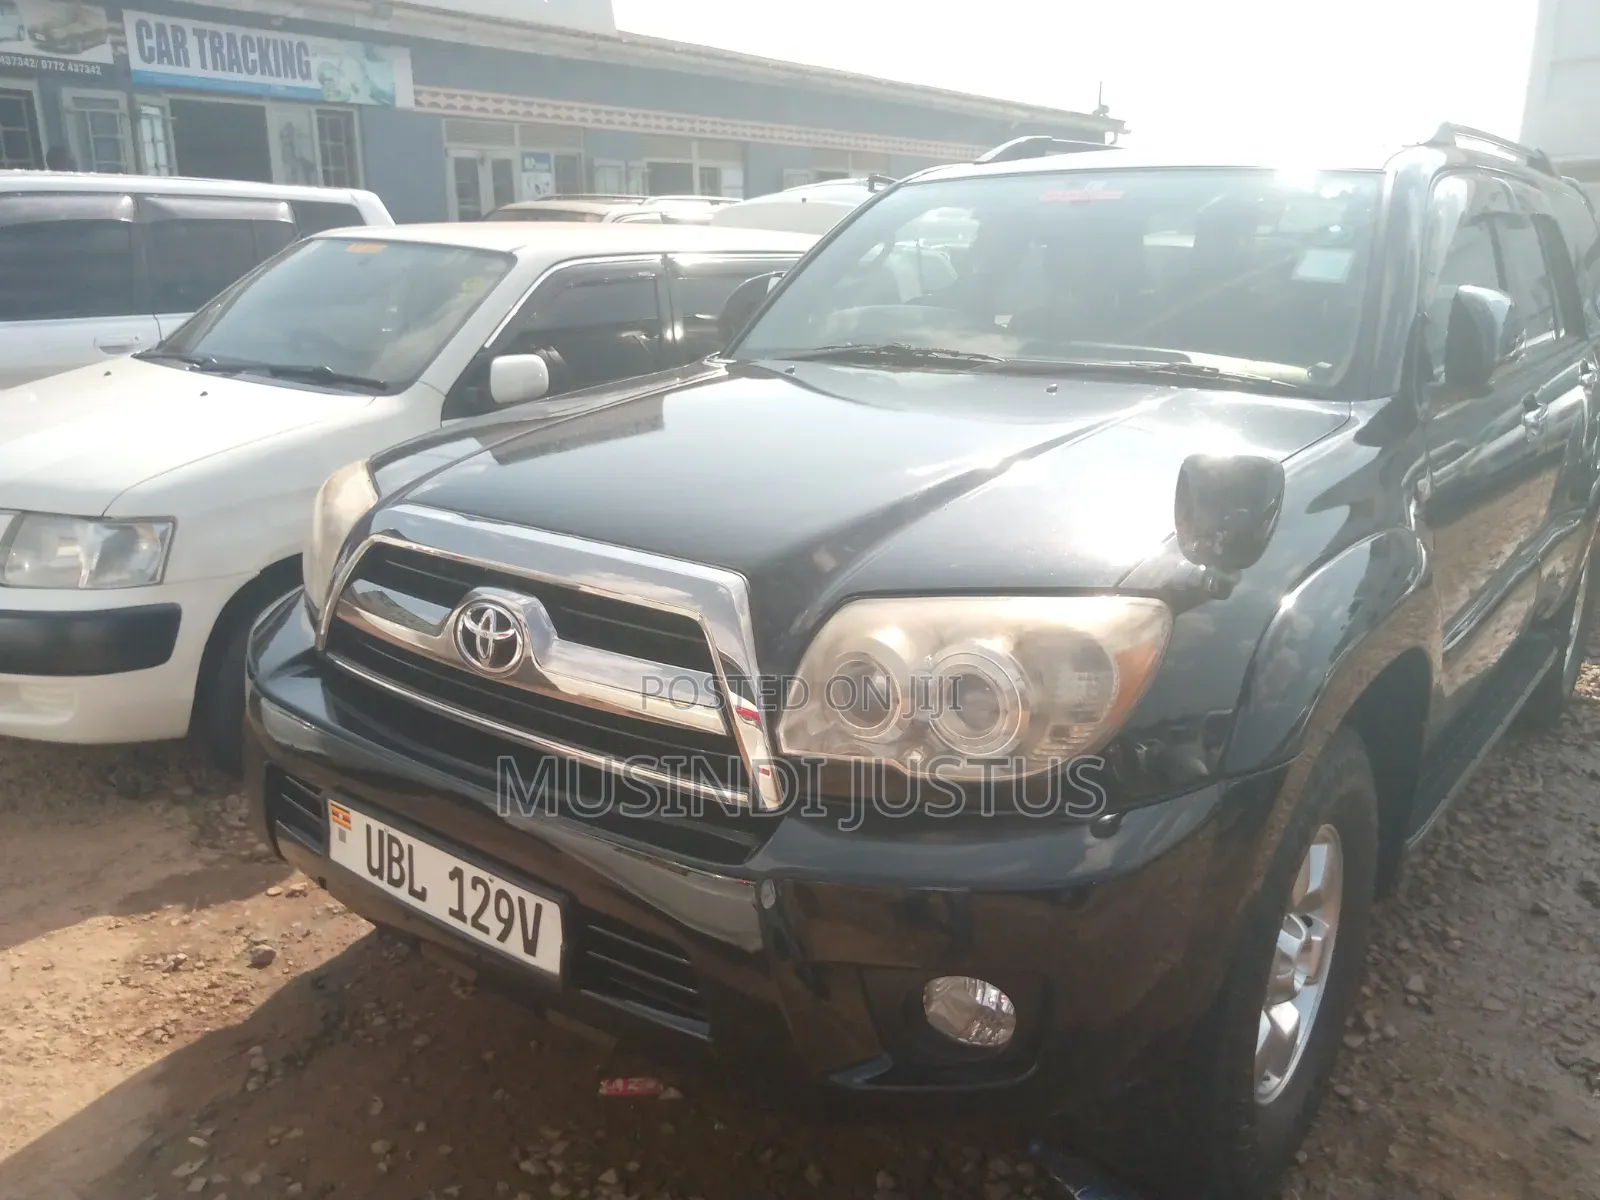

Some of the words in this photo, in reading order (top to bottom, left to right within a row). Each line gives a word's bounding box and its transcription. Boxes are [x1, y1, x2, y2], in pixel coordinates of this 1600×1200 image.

[135, 18, 191, 68] CAR
[192, 27, 312, 81] TRACKING
[366, 823, 427, 902] UBL
[448, 865, 543, 958] 129V
